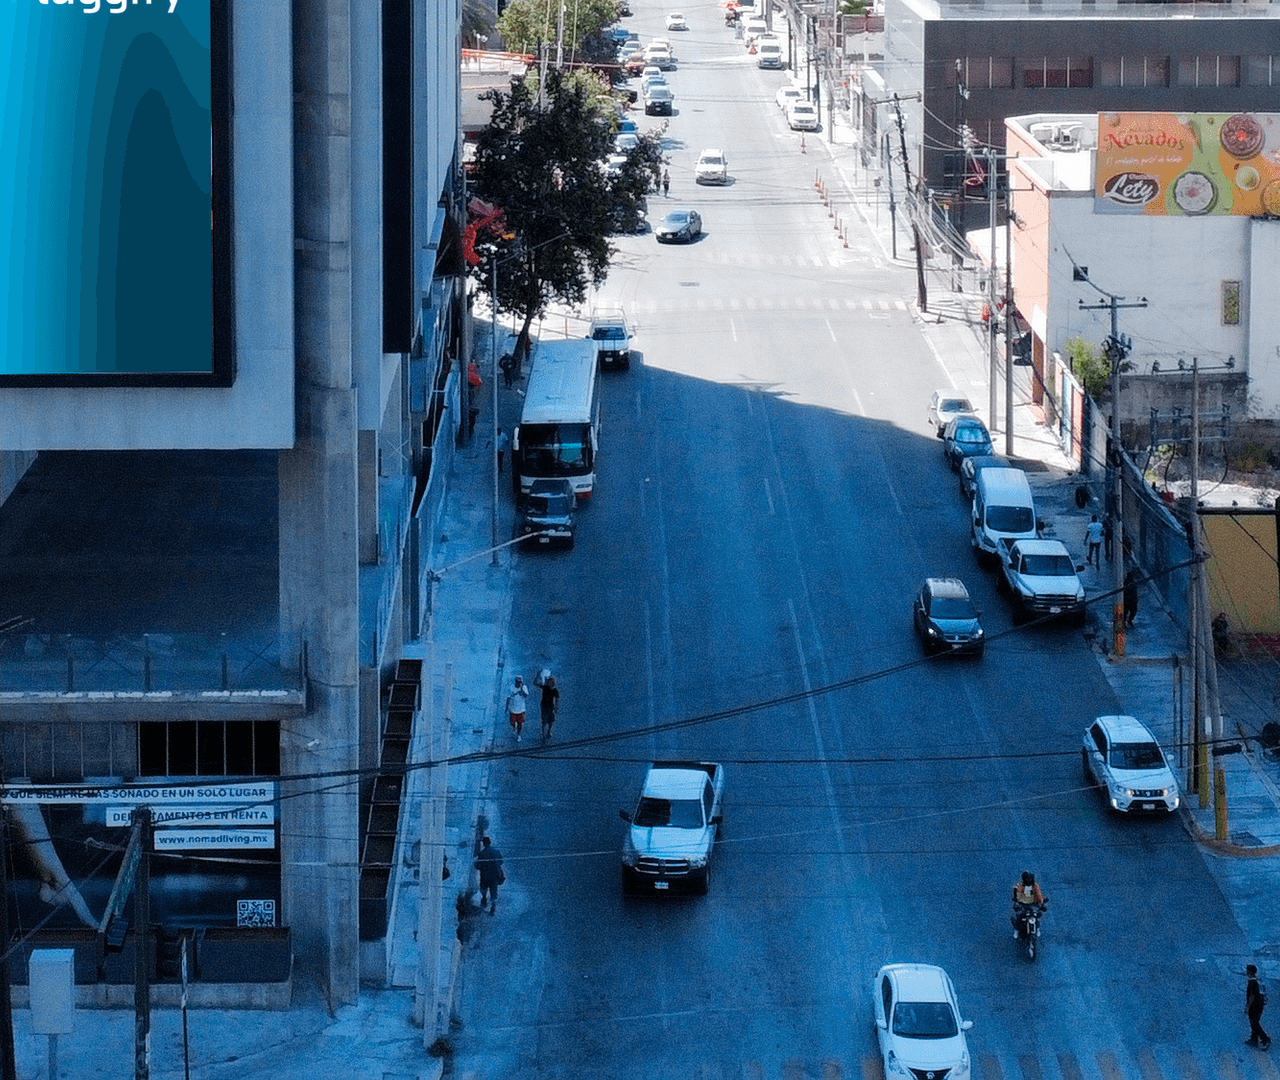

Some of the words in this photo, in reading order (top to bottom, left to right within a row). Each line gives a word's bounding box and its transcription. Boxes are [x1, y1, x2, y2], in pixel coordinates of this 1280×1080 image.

[1103, 131, 1185, 151] Nevados
[1104, 173, 1154, 204] Lety
[179, 789, 194, 797] UN
[229, 788, 266, 797] LUGAR
[231, 811, 268, 819] RENTA
[159, 835, 268, 844] www.nomadliving.mx
